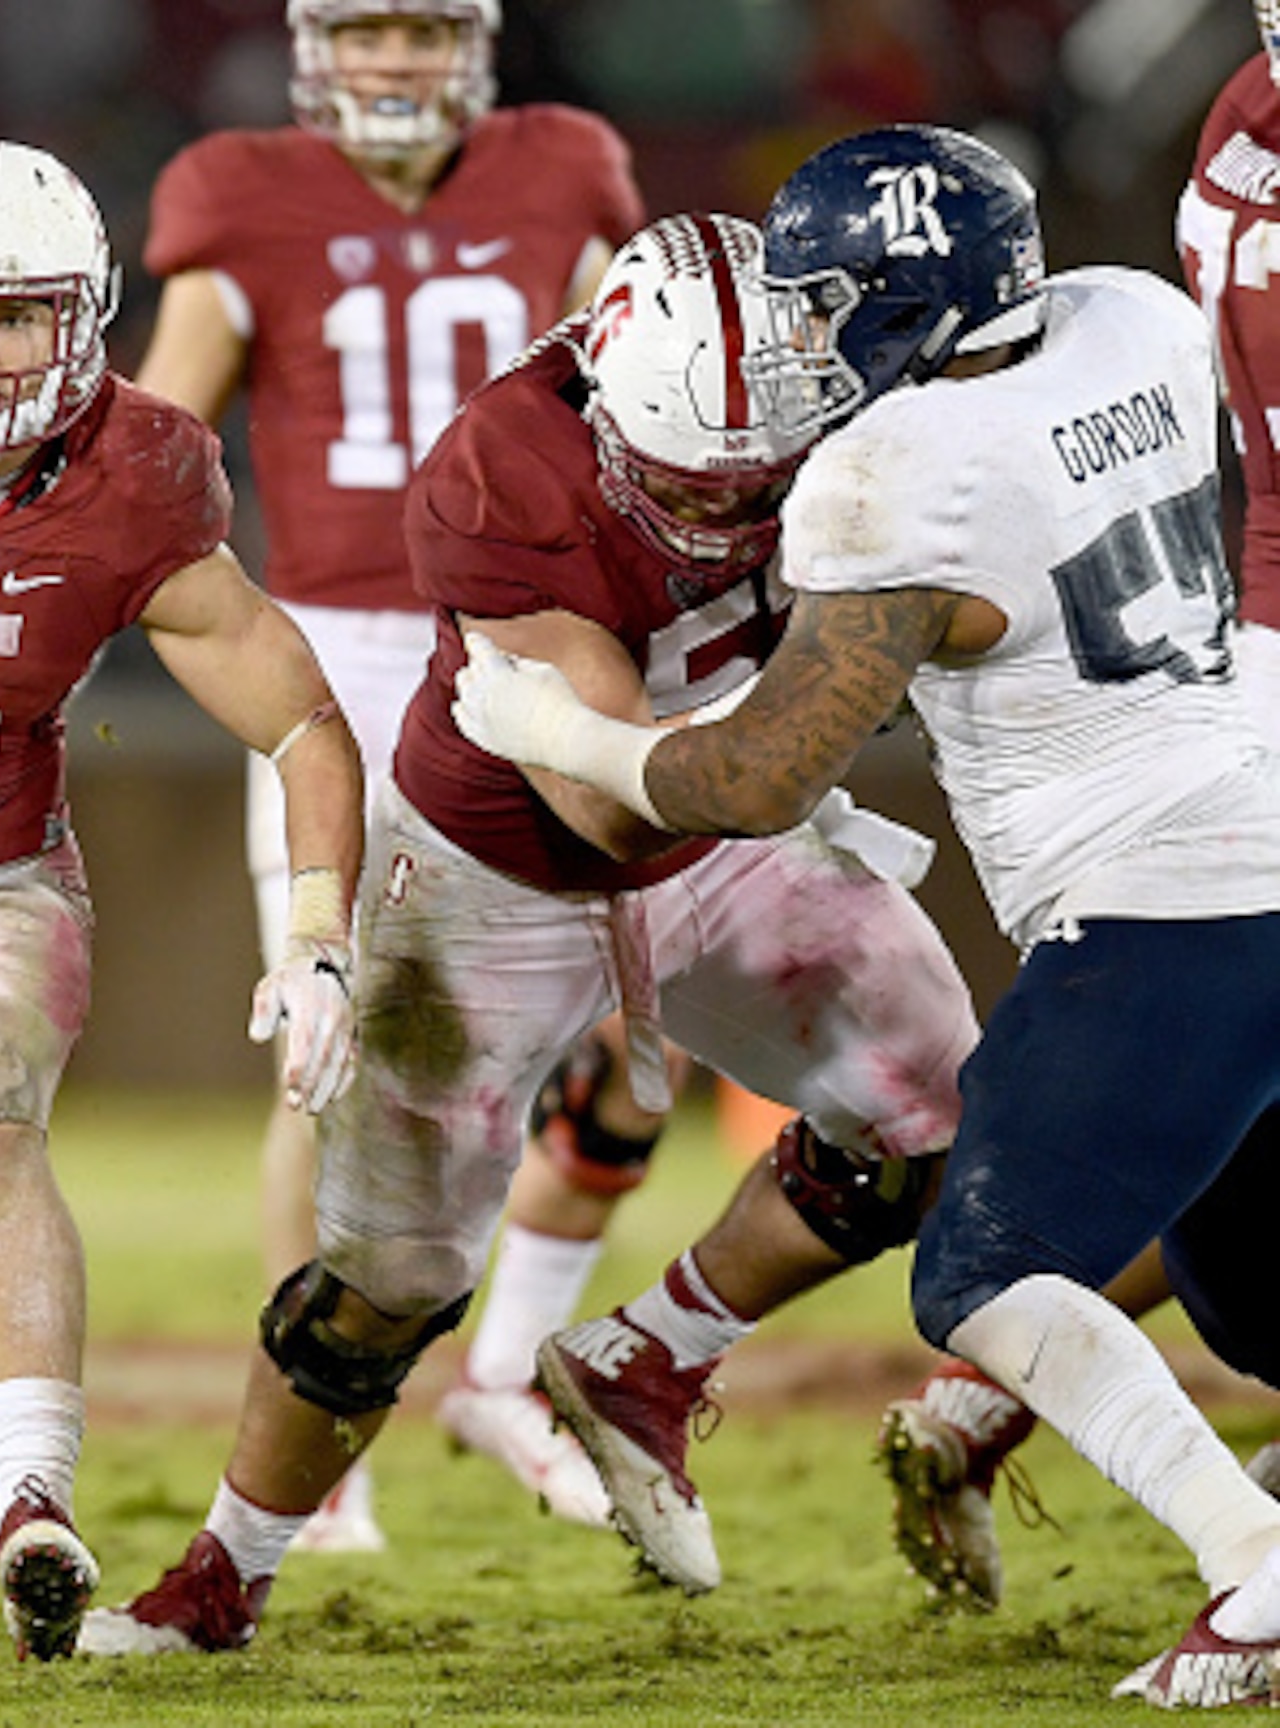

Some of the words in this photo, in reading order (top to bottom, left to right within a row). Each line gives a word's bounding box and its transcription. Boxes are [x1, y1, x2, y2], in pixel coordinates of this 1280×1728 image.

[323, 274, 529, 491] 10
[1051, 382, 1187, 483] GORDON
[556, 1317, 649, 1381] NIKE
[924, 1376, 1020, 1441] NIKE
